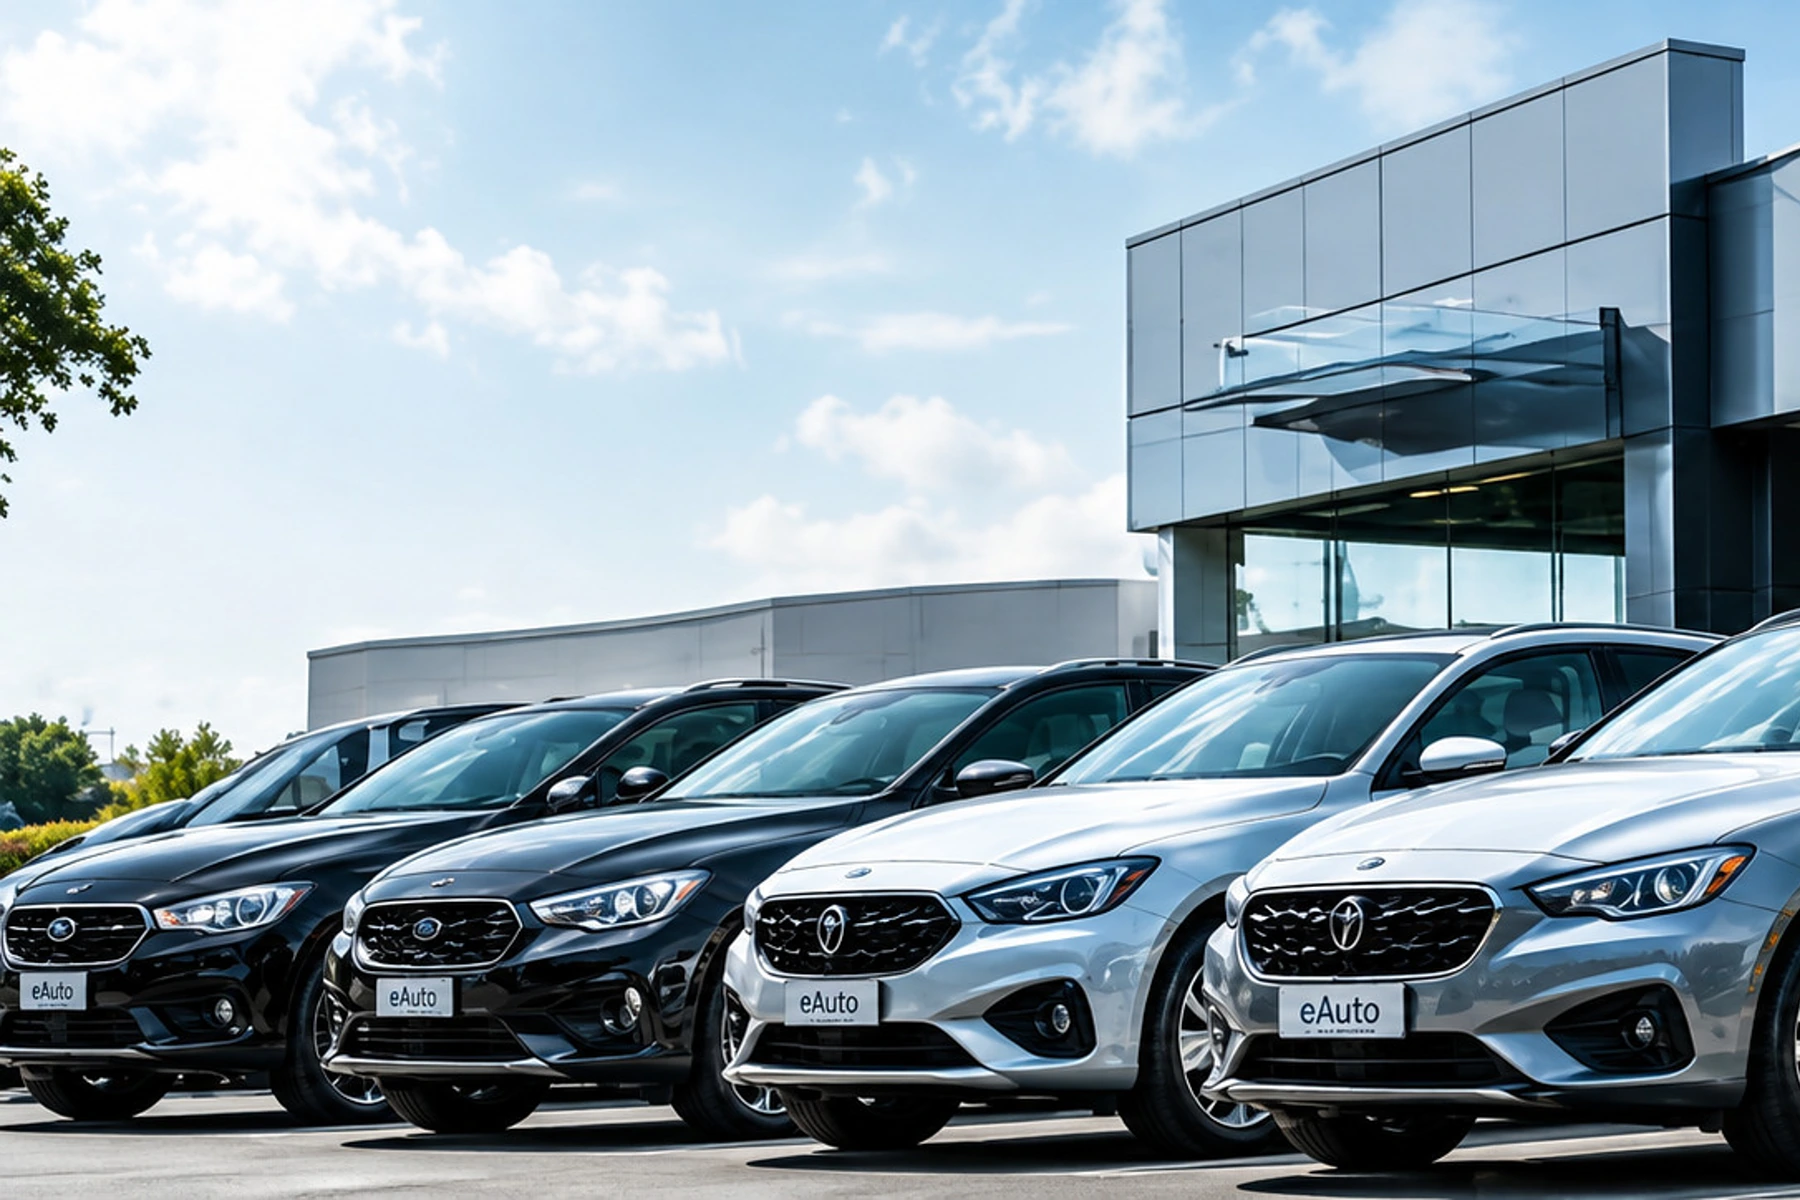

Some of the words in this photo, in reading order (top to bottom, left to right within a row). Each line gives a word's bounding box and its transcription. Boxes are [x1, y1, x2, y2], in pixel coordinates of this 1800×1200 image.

[32, 981, 74, 1000] eAuto
[390, 986, 437, 1007] eAuto
[800, 990, 859, 1014] eAuto
[1300, 995, 1380, 1024] eAuto
